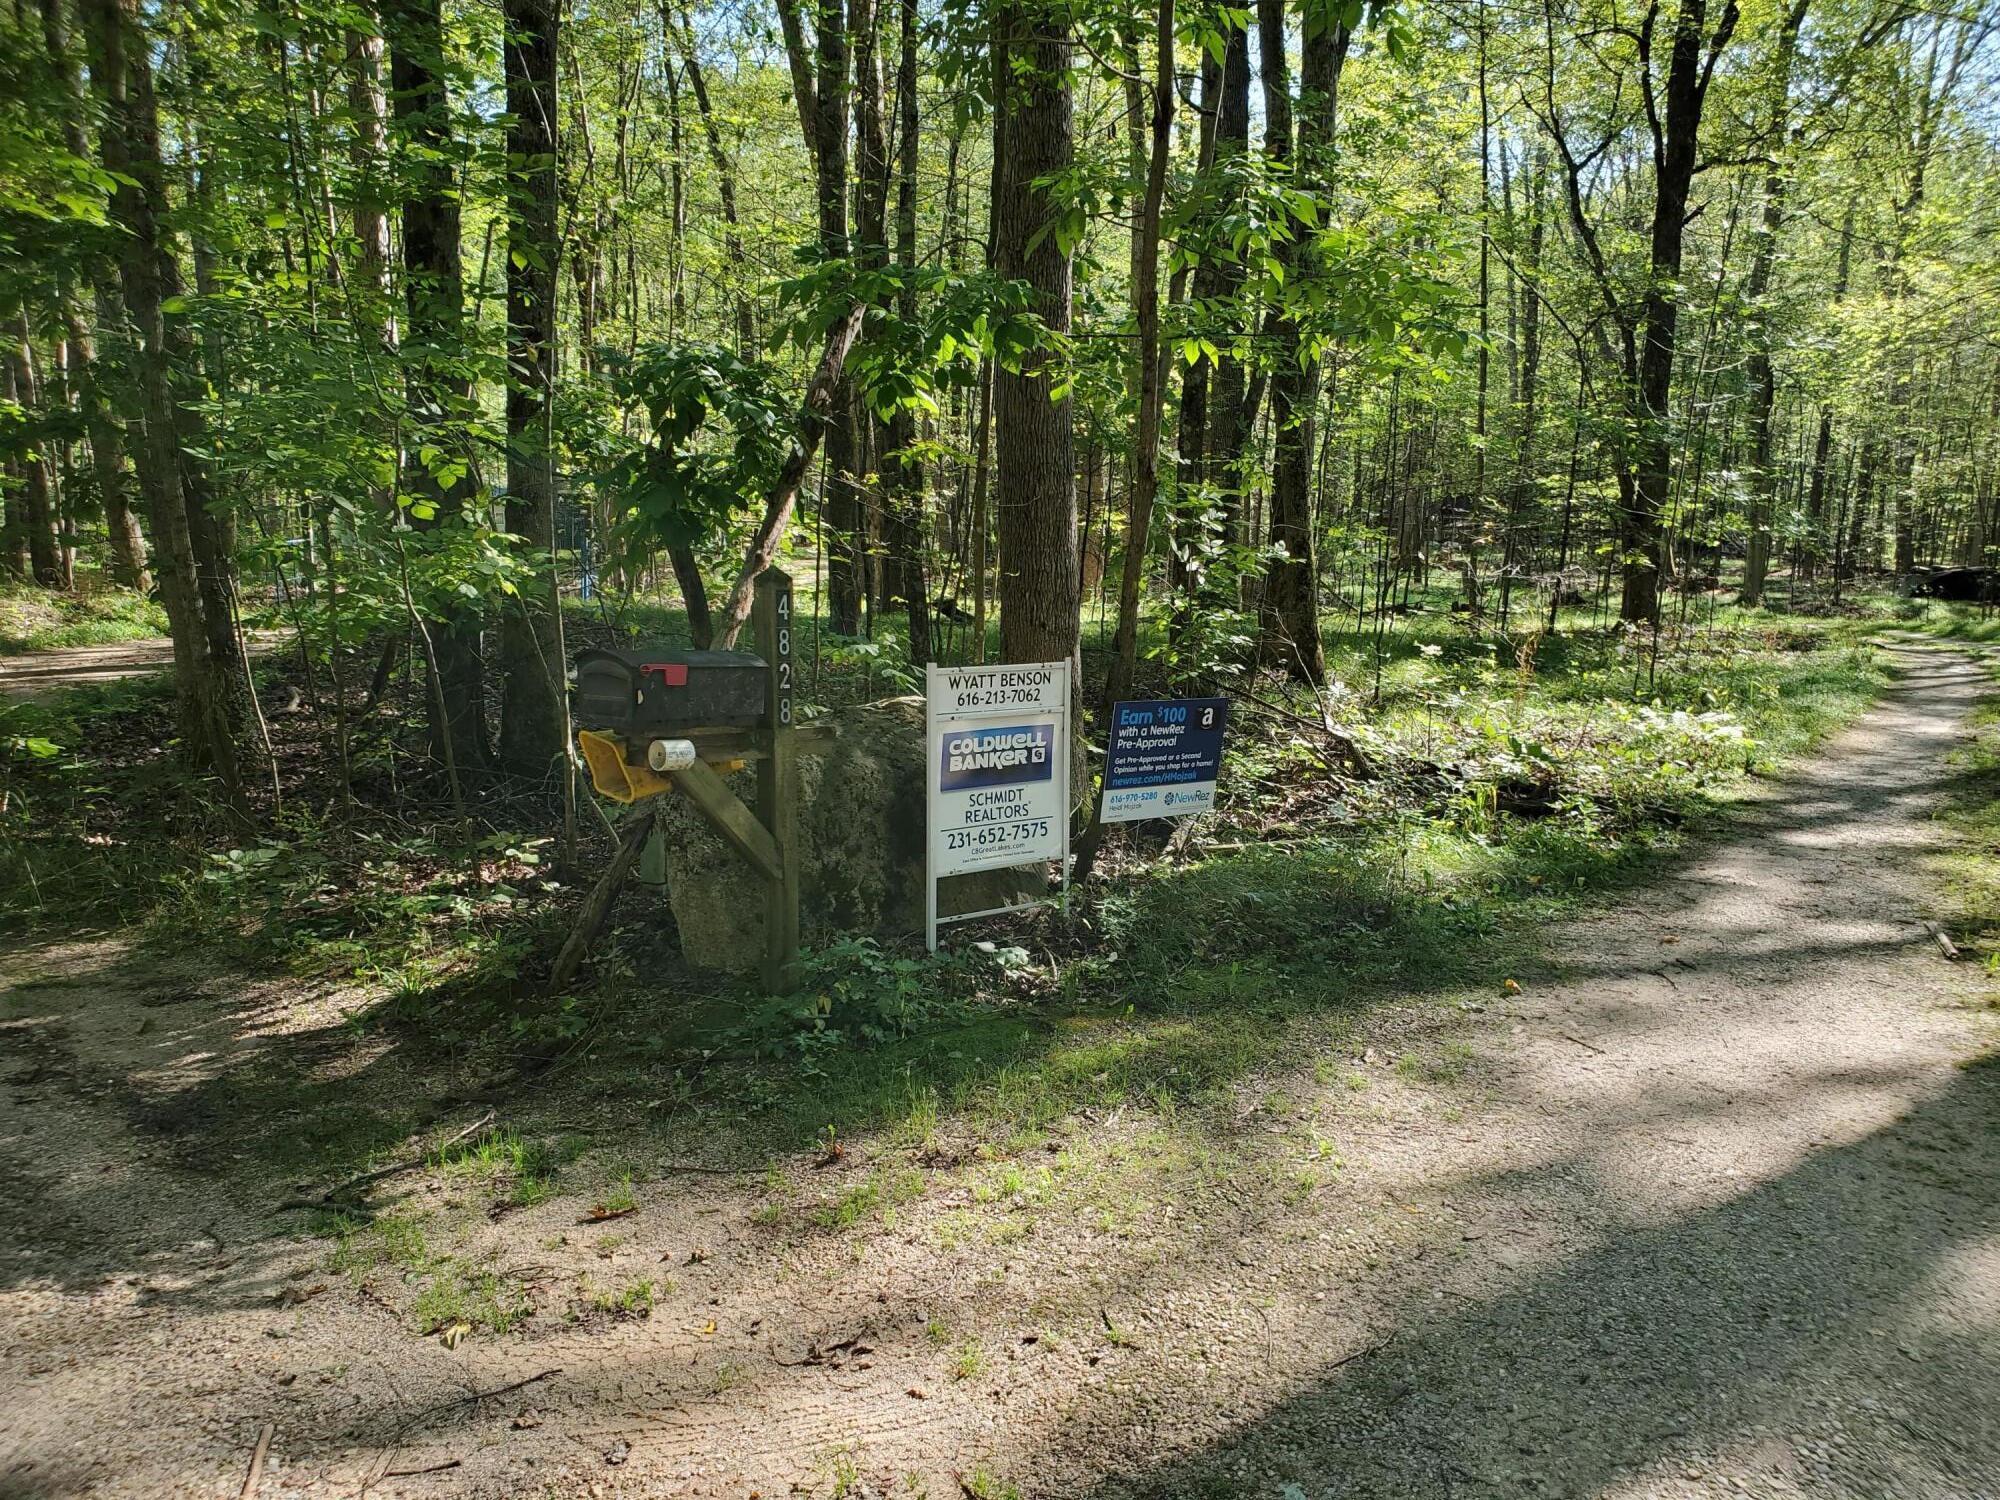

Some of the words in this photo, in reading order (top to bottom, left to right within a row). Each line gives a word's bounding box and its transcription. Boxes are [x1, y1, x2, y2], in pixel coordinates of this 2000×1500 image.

[777, 594, 791, 724] 4828
[949, 674, 996, 690] WYATT
[1000, 672, 1051, 687] BENSON
[957, 688, 1041, 706] 616-213-7062
[1120, 709, 1153, 725] Earn
[1158, 706, 1187, 723] $100
[1202, 707, 1214, 726] a
[1118, 726, 1139, 738] with
[1140, 728, 1148, 737] a
[1150, 724, 1185, 736] NewRez
[949, 732, 1047, 755] COLDWELL
[1117, 736, 1177, 751] Pre-Approval
[949, 749, 1028, 772] BANKER
[1113, 766, 1138, 774] Opinion
[1155, 764, 1166, 772] you
[1166, 762, 1181, 770] shop
[1181, 761, 1190, 769] for
[1114, 757, 1126, 765] Get
[1127, 754, 1167, 764] Pre-Approved
[1181, 752, 1202, 760] Second
[969, 788, 1025, 807] SCHMIDT
[1174, 790, 1210, 804] NewRez
[947, 821, 1048, 850] 231-652-7575
